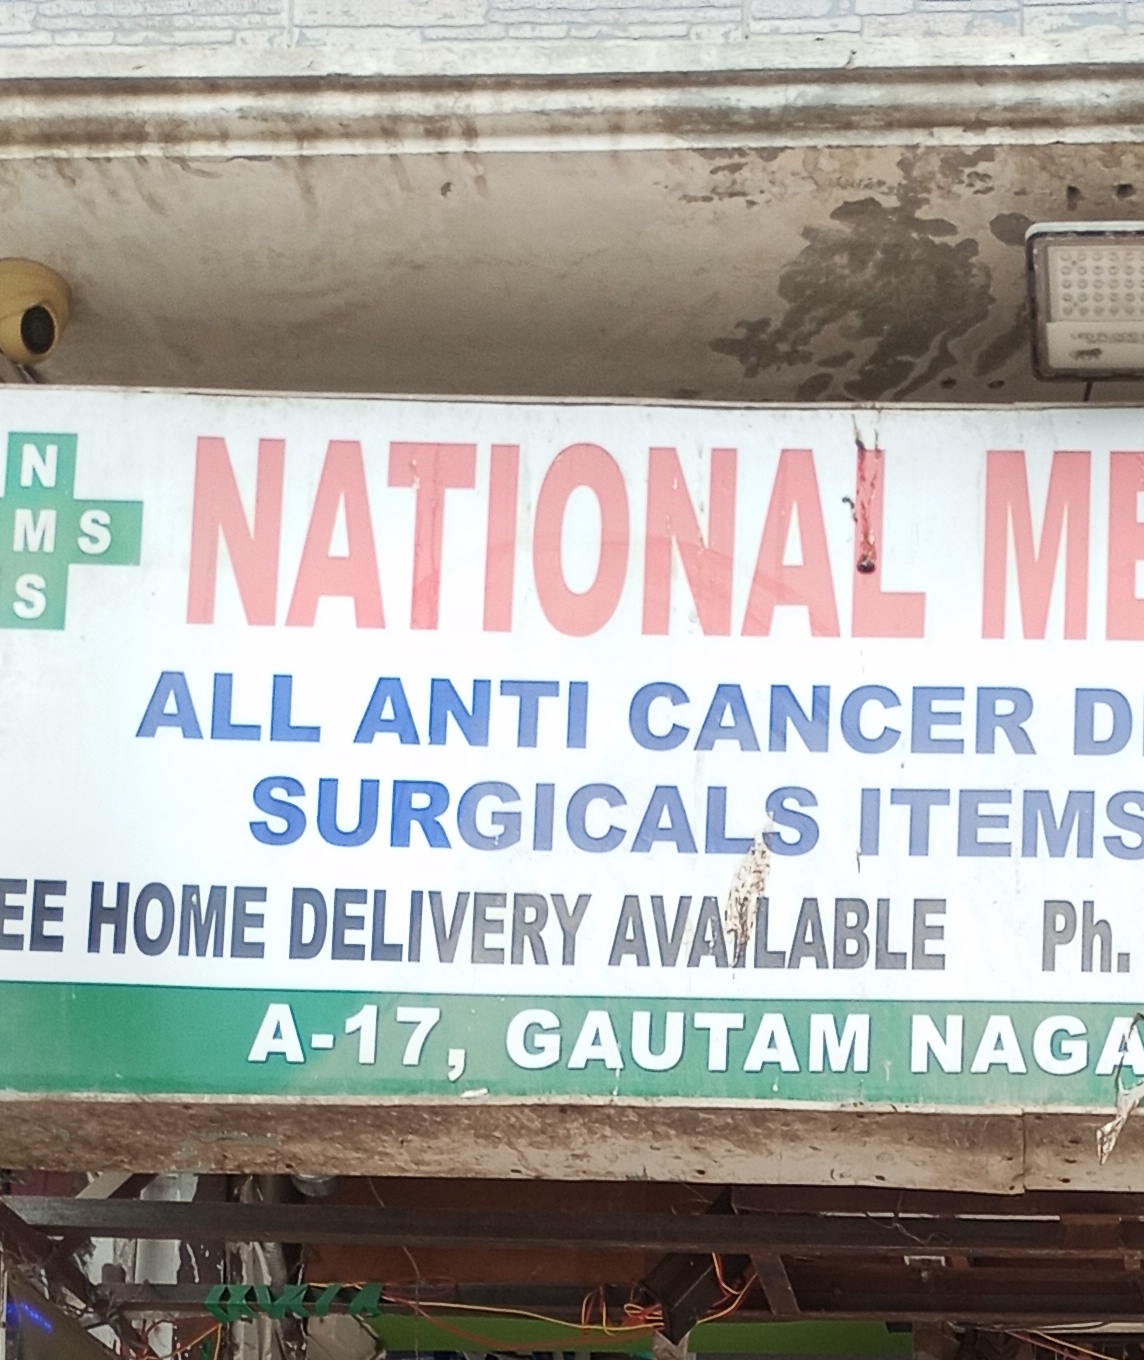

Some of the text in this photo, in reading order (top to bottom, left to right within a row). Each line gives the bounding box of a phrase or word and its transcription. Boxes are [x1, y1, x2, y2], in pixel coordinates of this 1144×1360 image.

[186, 436, 926, 642] NATIONAL
[135, 669, 322, 744] ALL
[353, 676, 590, 750] ANTI
[628, 681, 1038, 756] CANCER
[248, 775, 820, 858] SURGICALS
[87, 881, 267, 961] HOME
[287, 887, 592, 968] DELIVERY
[608, 893, 947, 972] AVAILABLE
[1041, 898, 1131, 975] Ph.
[247, 1002, 468, 1083] A-17,
[505, 1008, 872, 1077] GAUTAM
